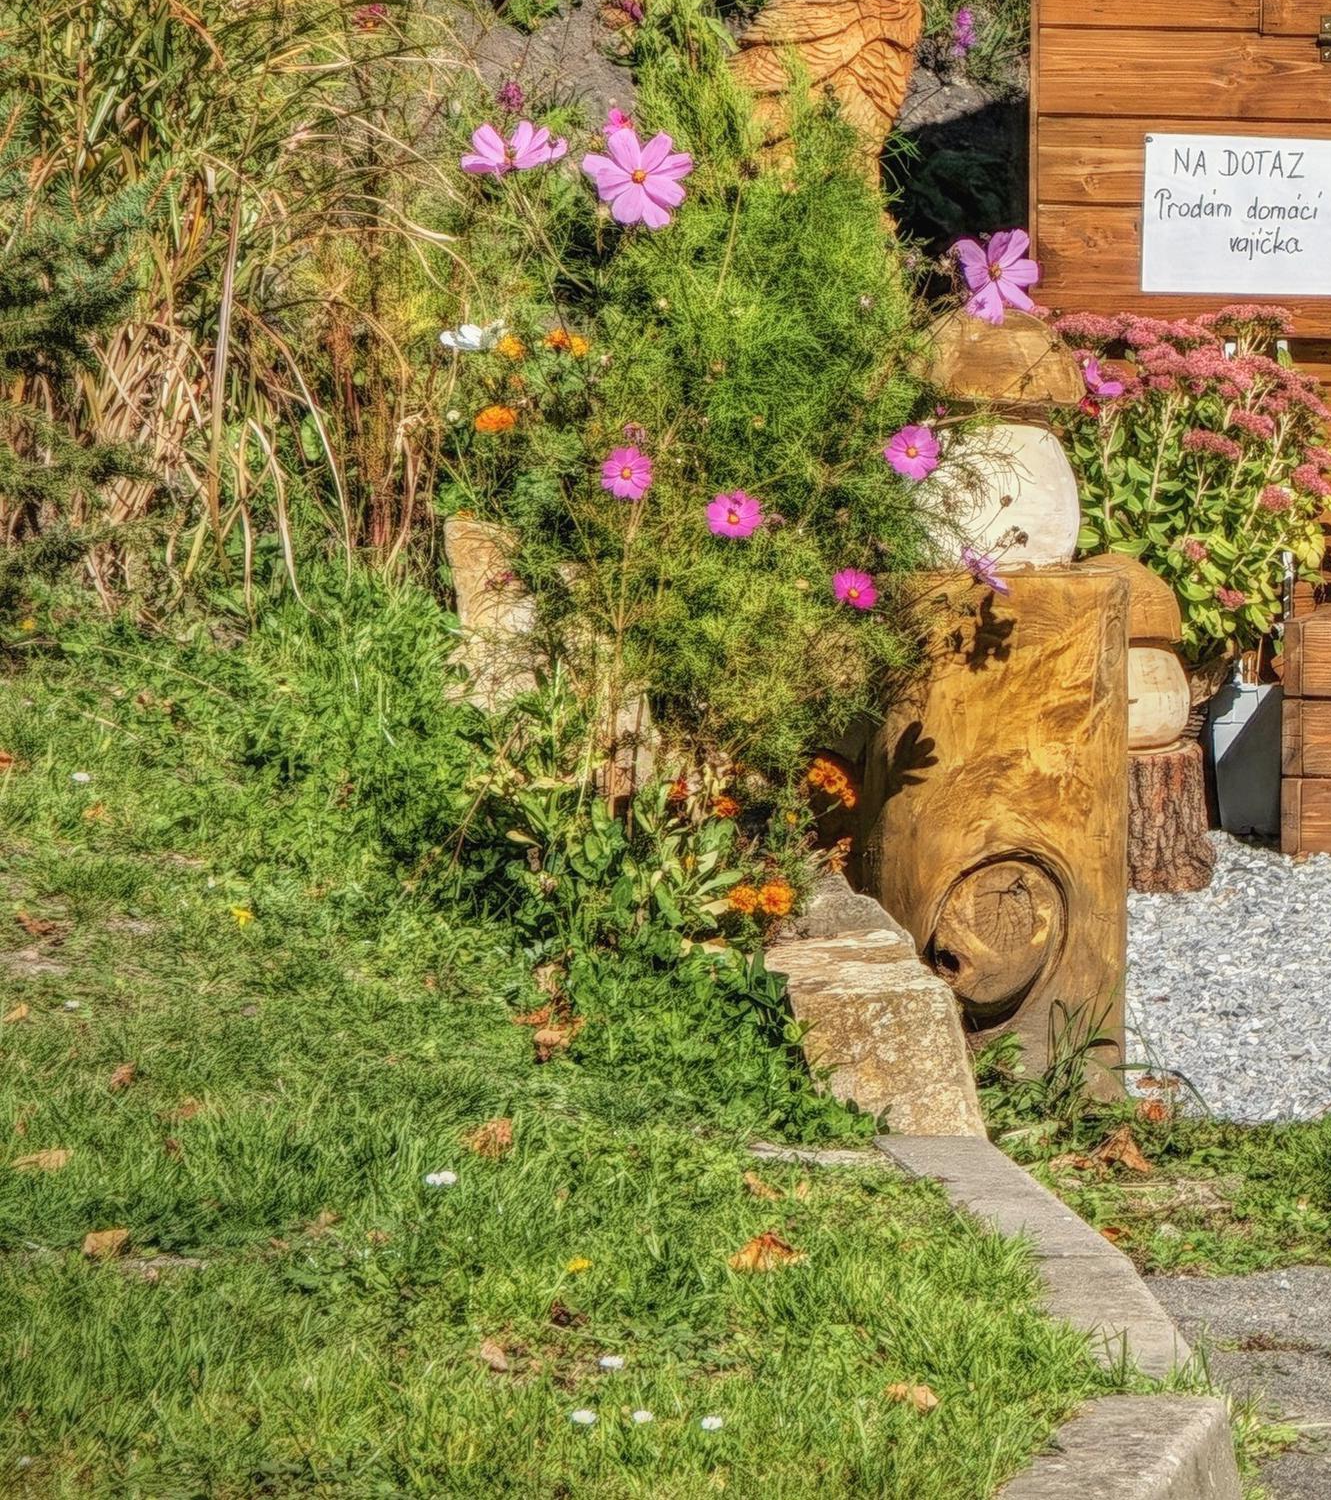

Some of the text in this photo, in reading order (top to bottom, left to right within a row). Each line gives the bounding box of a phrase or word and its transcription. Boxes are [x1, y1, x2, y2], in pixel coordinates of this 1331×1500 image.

[1173, 147, 1305, 179] NA DOTAZ
[1154, 188, 1323, 221] Prodám domácí
[1229, 227, 1303, 261] vajíčka
